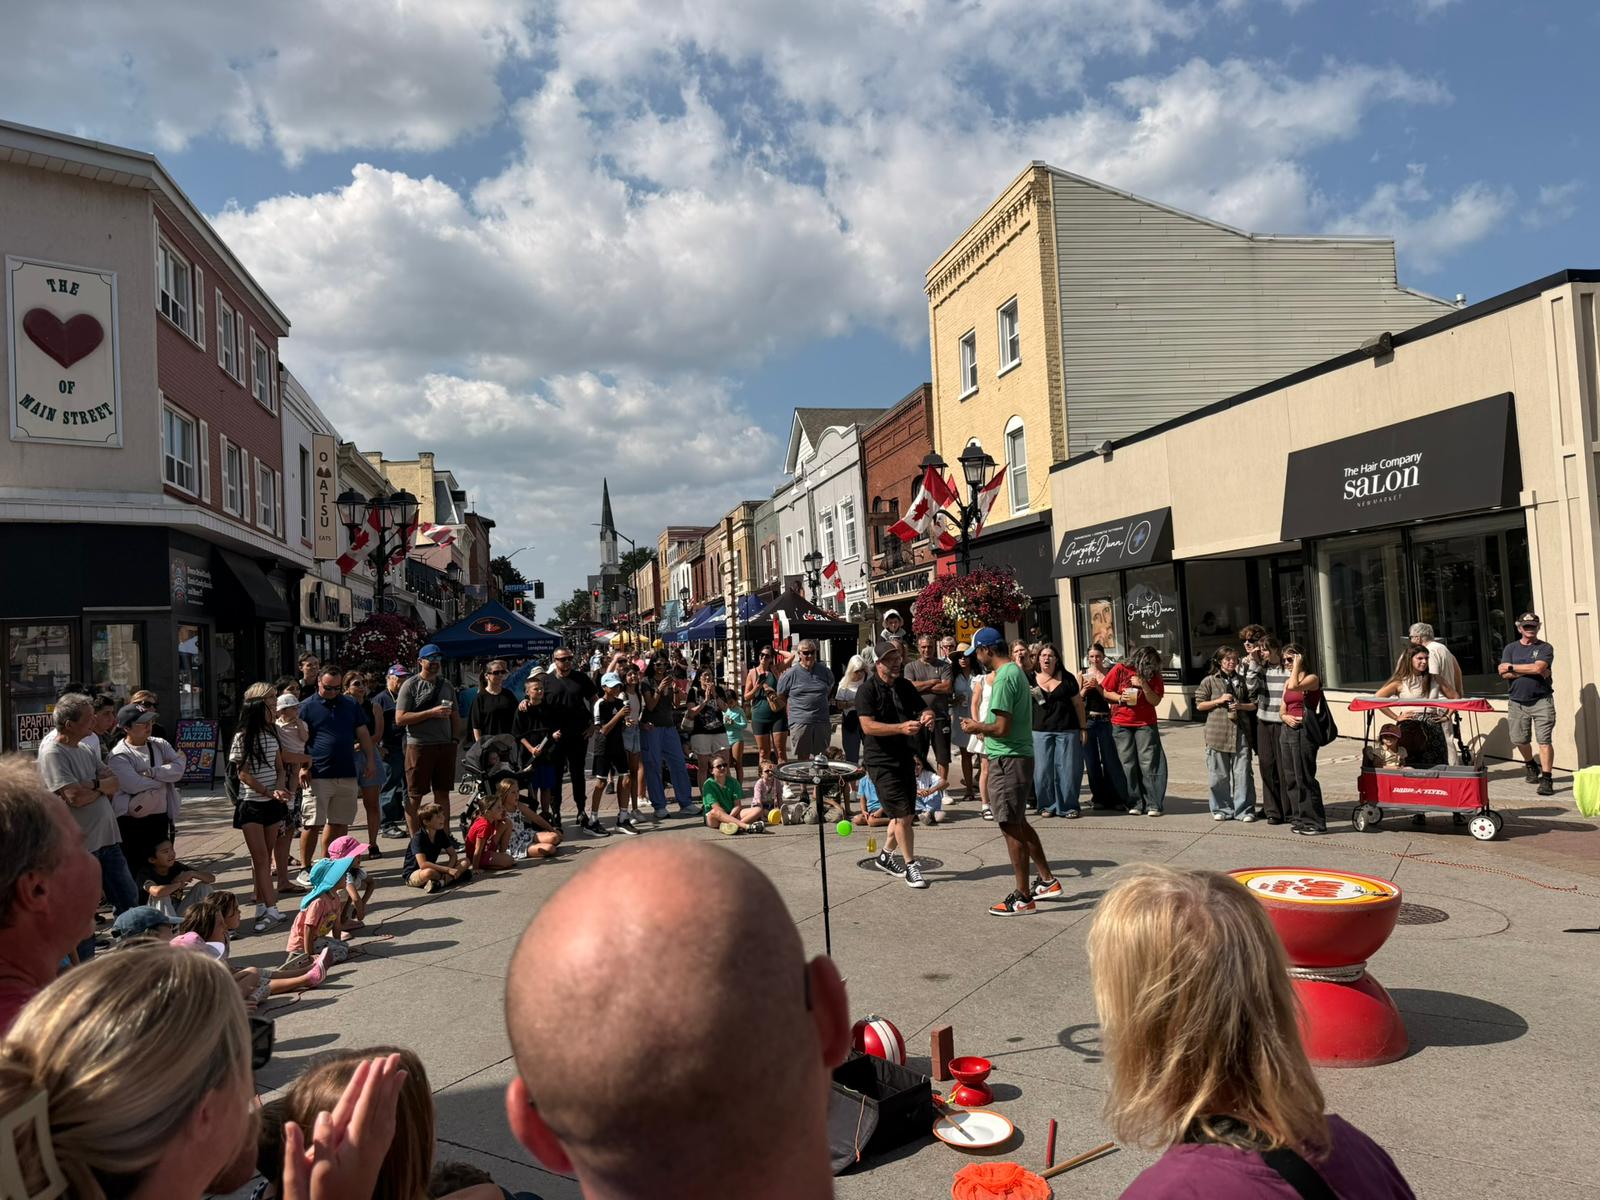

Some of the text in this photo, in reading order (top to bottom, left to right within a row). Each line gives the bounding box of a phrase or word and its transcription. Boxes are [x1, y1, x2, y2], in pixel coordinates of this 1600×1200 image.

[46, 278, 80, 296] THE
[59, 380, 76, 395] OF
[18, 393, 114, 425] MAIN STREET
[1343, 452, 1423, 478] The Hair Company
[1076, 556, 1101, 566] CLINIC
[1142, 619, 1161, 630] CLINIC
[20, 714, 56, 728] APARTM
[19, 727, 40, 741] FOR
[180, 732, 213, 740] JAZZIS
